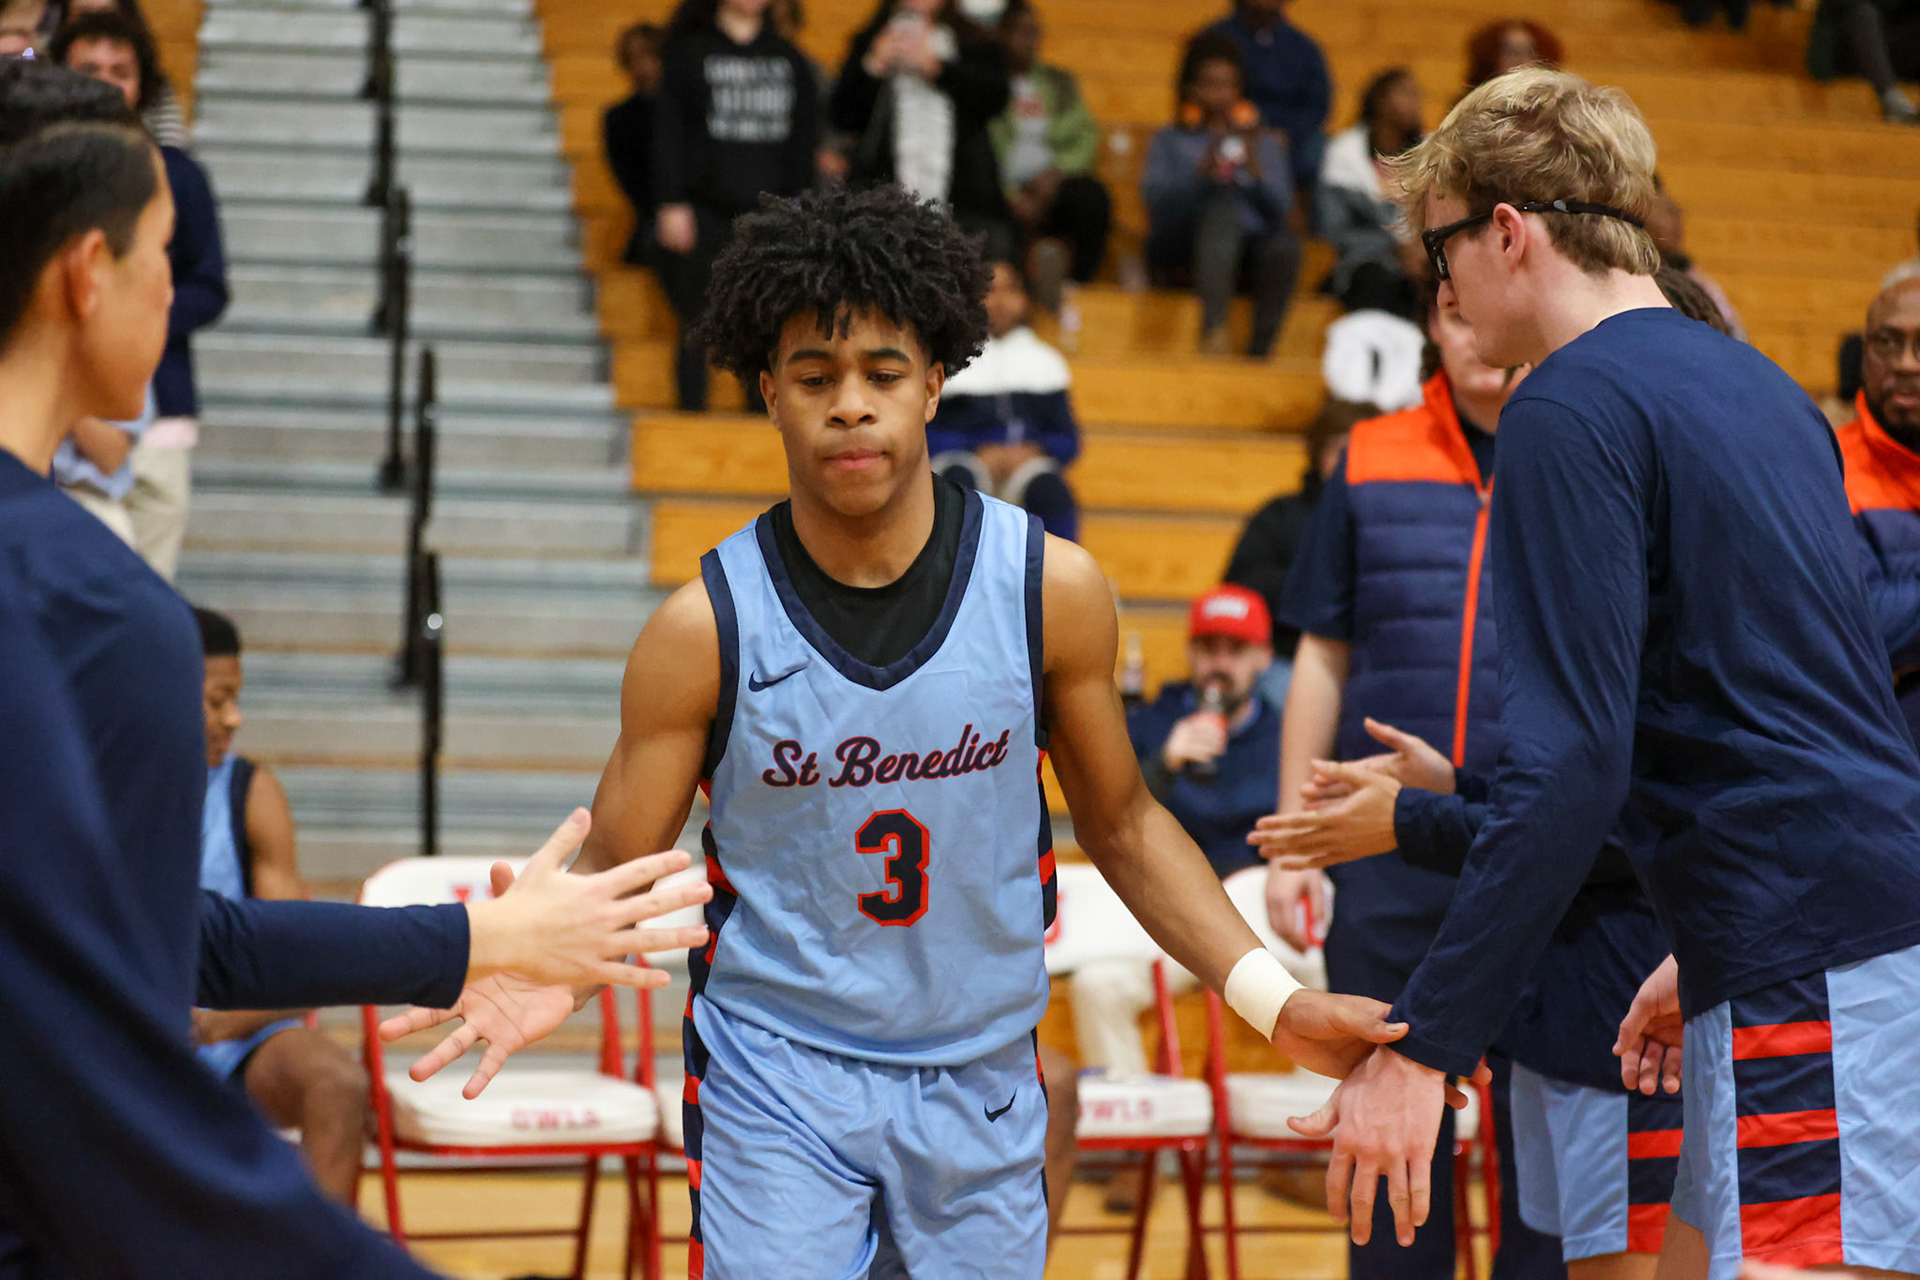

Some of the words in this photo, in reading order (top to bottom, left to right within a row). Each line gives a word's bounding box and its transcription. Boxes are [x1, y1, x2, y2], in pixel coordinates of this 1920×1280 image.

[762, 739, 820, 787] St
[828, 724, 1010, 788] Benedict
[855, 808, 930, 928] 3
